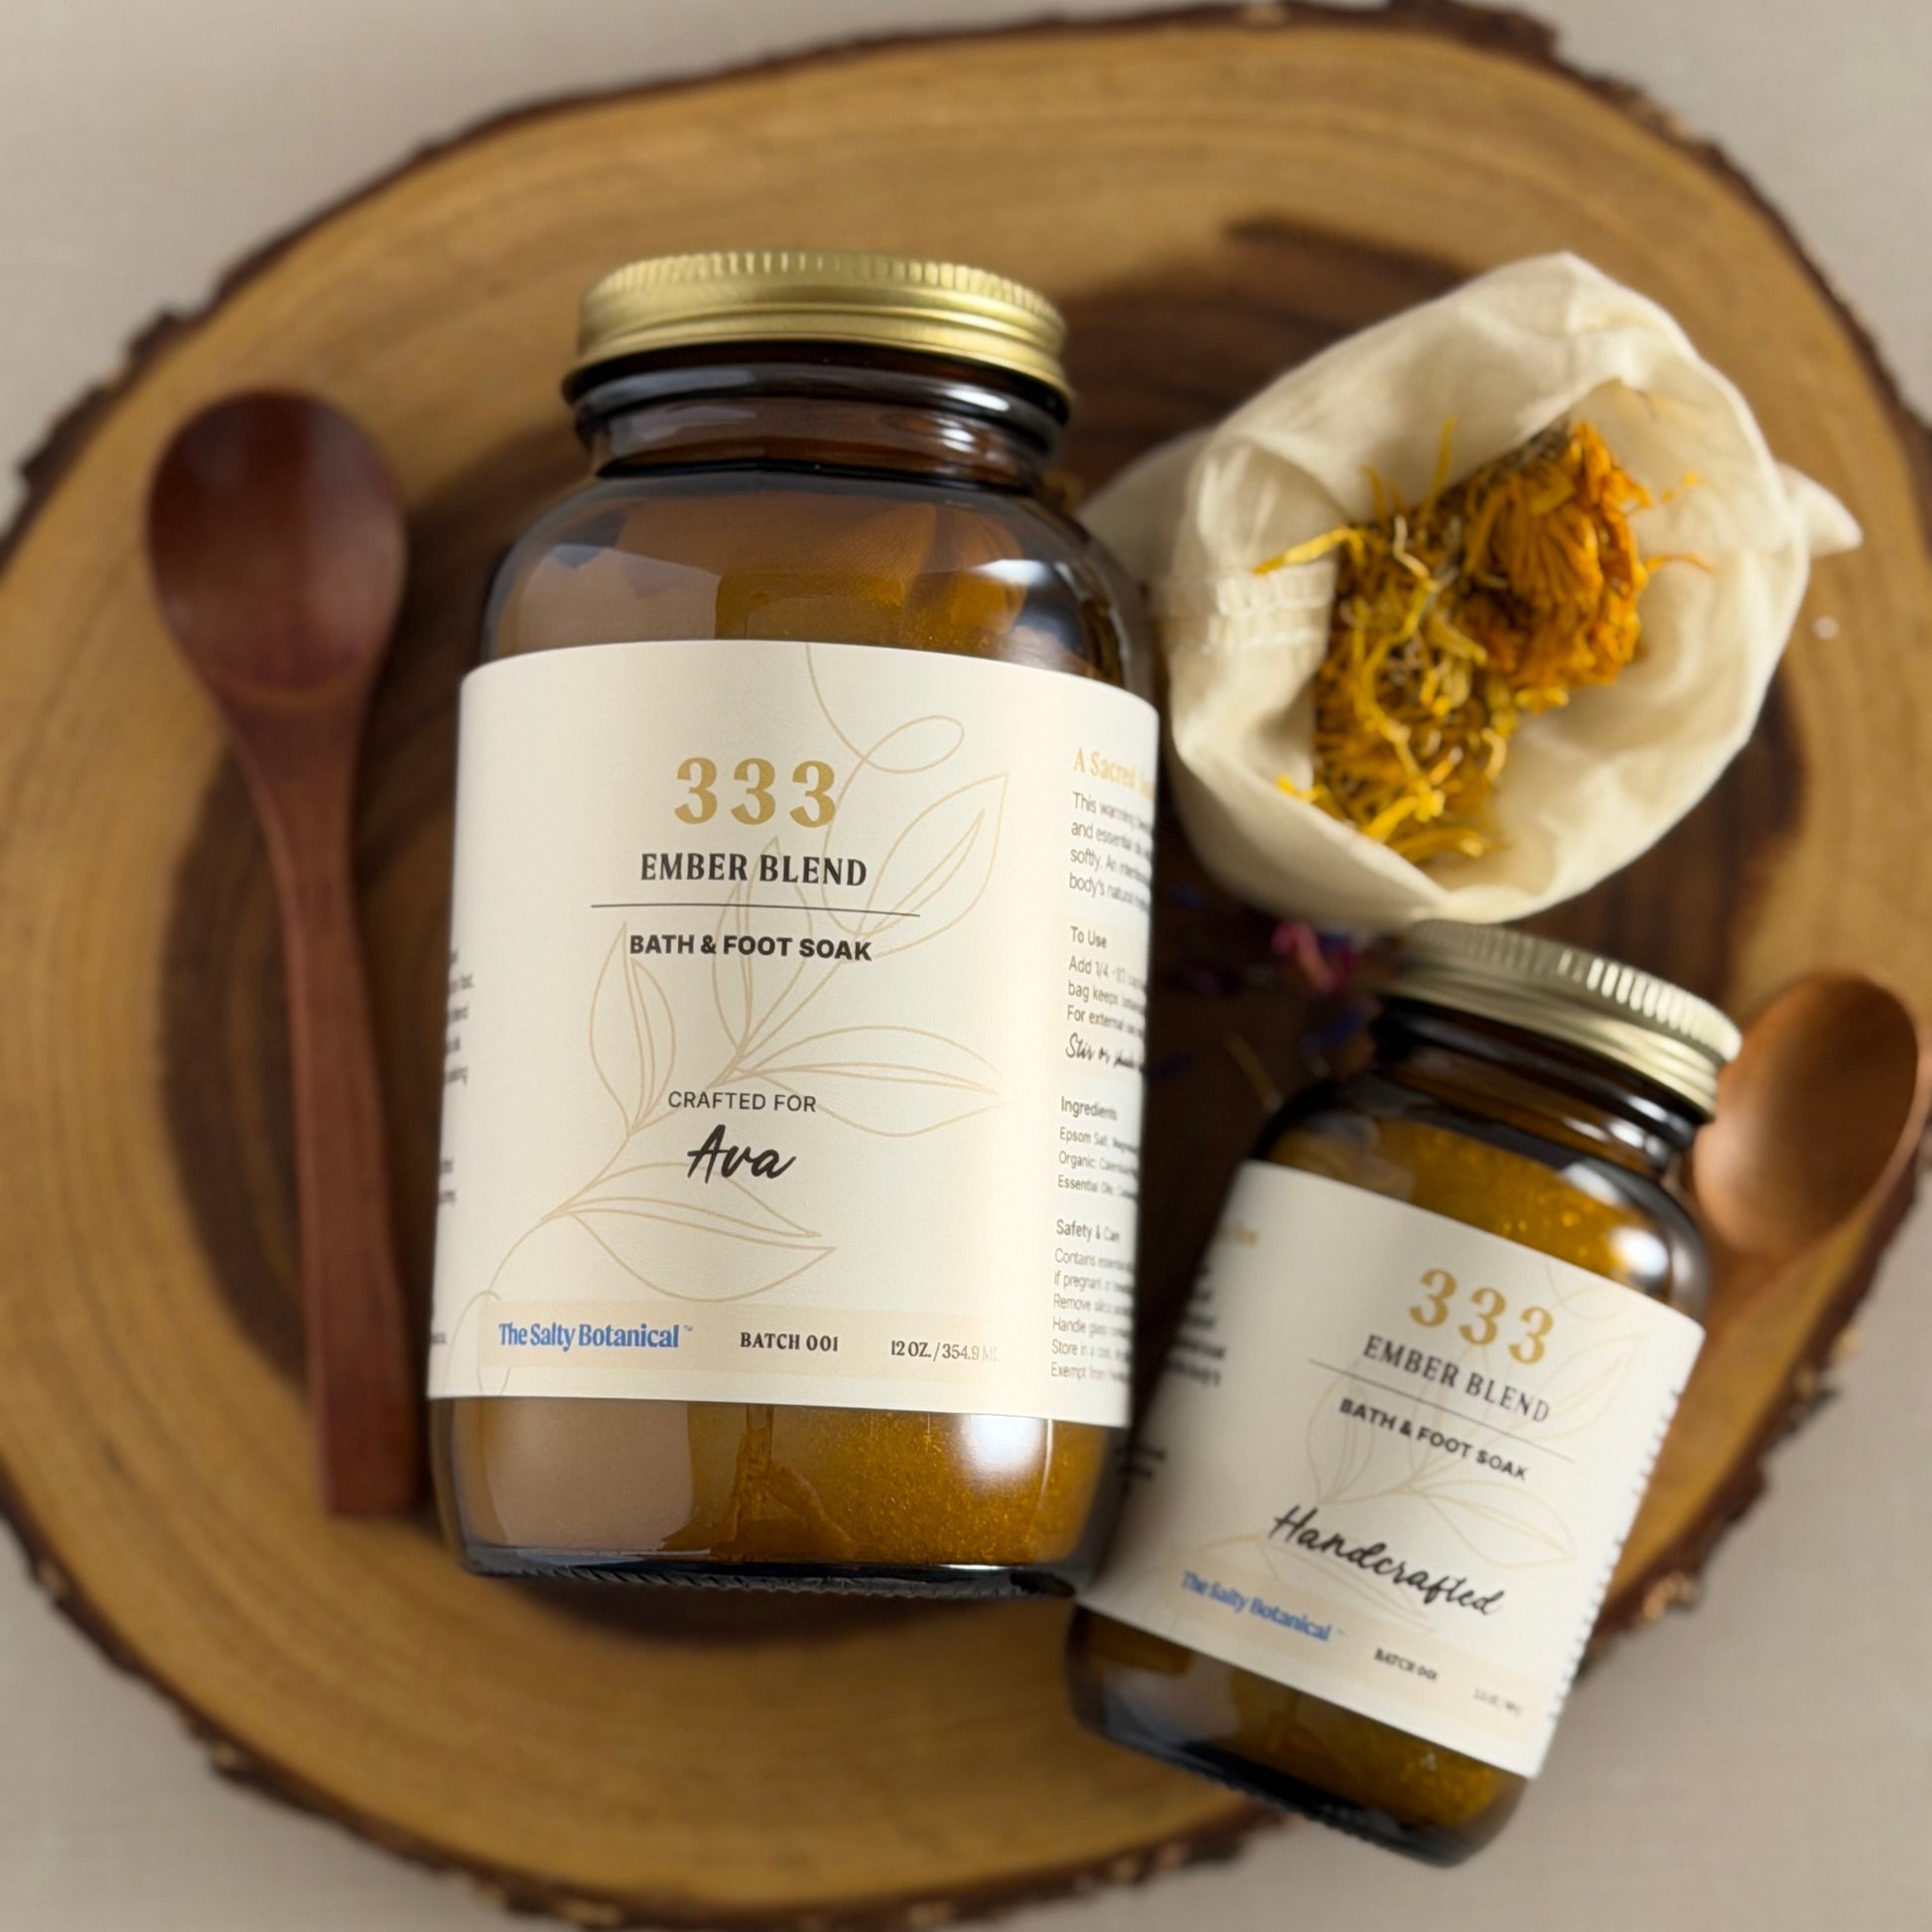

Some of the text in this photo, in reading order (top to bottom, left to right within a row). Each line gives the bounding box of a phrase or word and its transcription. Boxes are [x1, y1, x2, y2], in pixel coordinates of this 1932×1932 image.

[1073, 748, 1085, 773] A
[674, 757, 836, 828] 333
[1072, 791, 1097, 814] This
[1071, 822, 1093, 840] and
[640, 853, 867, 886] EMBER BLEND
[1069, 872, 1105, 897] body's
[629, 934, 872, 961] BATH & FOOT SOAK
[1070, 925, 1107, 949] To Use
[1069, 955, 1092, 974] Add
[1068, 980, 1089, 1003] bag
[1067, 1005, 1086, 1022] For
[668, 1091, 816, 1112] CRAFTED FOR
[1059, 1127, 1091, 1144] Epsom
[687, 1124, 796, 1183] Ava
[1056, 1218, 1093, 1242] Safety
[1055, 1248, 1096, 1267] Contains
[1053, 1294, 1091, 1311] Remove
[1052, 1316, 1086, 1333] Handle
[1409, 1268, 1553, 1364] 333
[498, 1321, 527, 1345] The
[530, 1321, 576, 1352] Salty
[578, 1322, 679, 1347] Botanical
[740, 1331, 838, 1351] BATCH 001
[891, 1340, 905, 1356] 12
[1051, 1339, 1077, 1355] Store
[1050, 1362, 1086, 1380] Exempt
[1363, 1334, 1550, 1423] EMBER BLEND
[1339, 1398, 1528, 1481] BATH & FOOT SOAK
[1269, 1505, 1504, 1615] Handcrafted
[1181, 1571, 1332, 1642] The Salty Botanical
